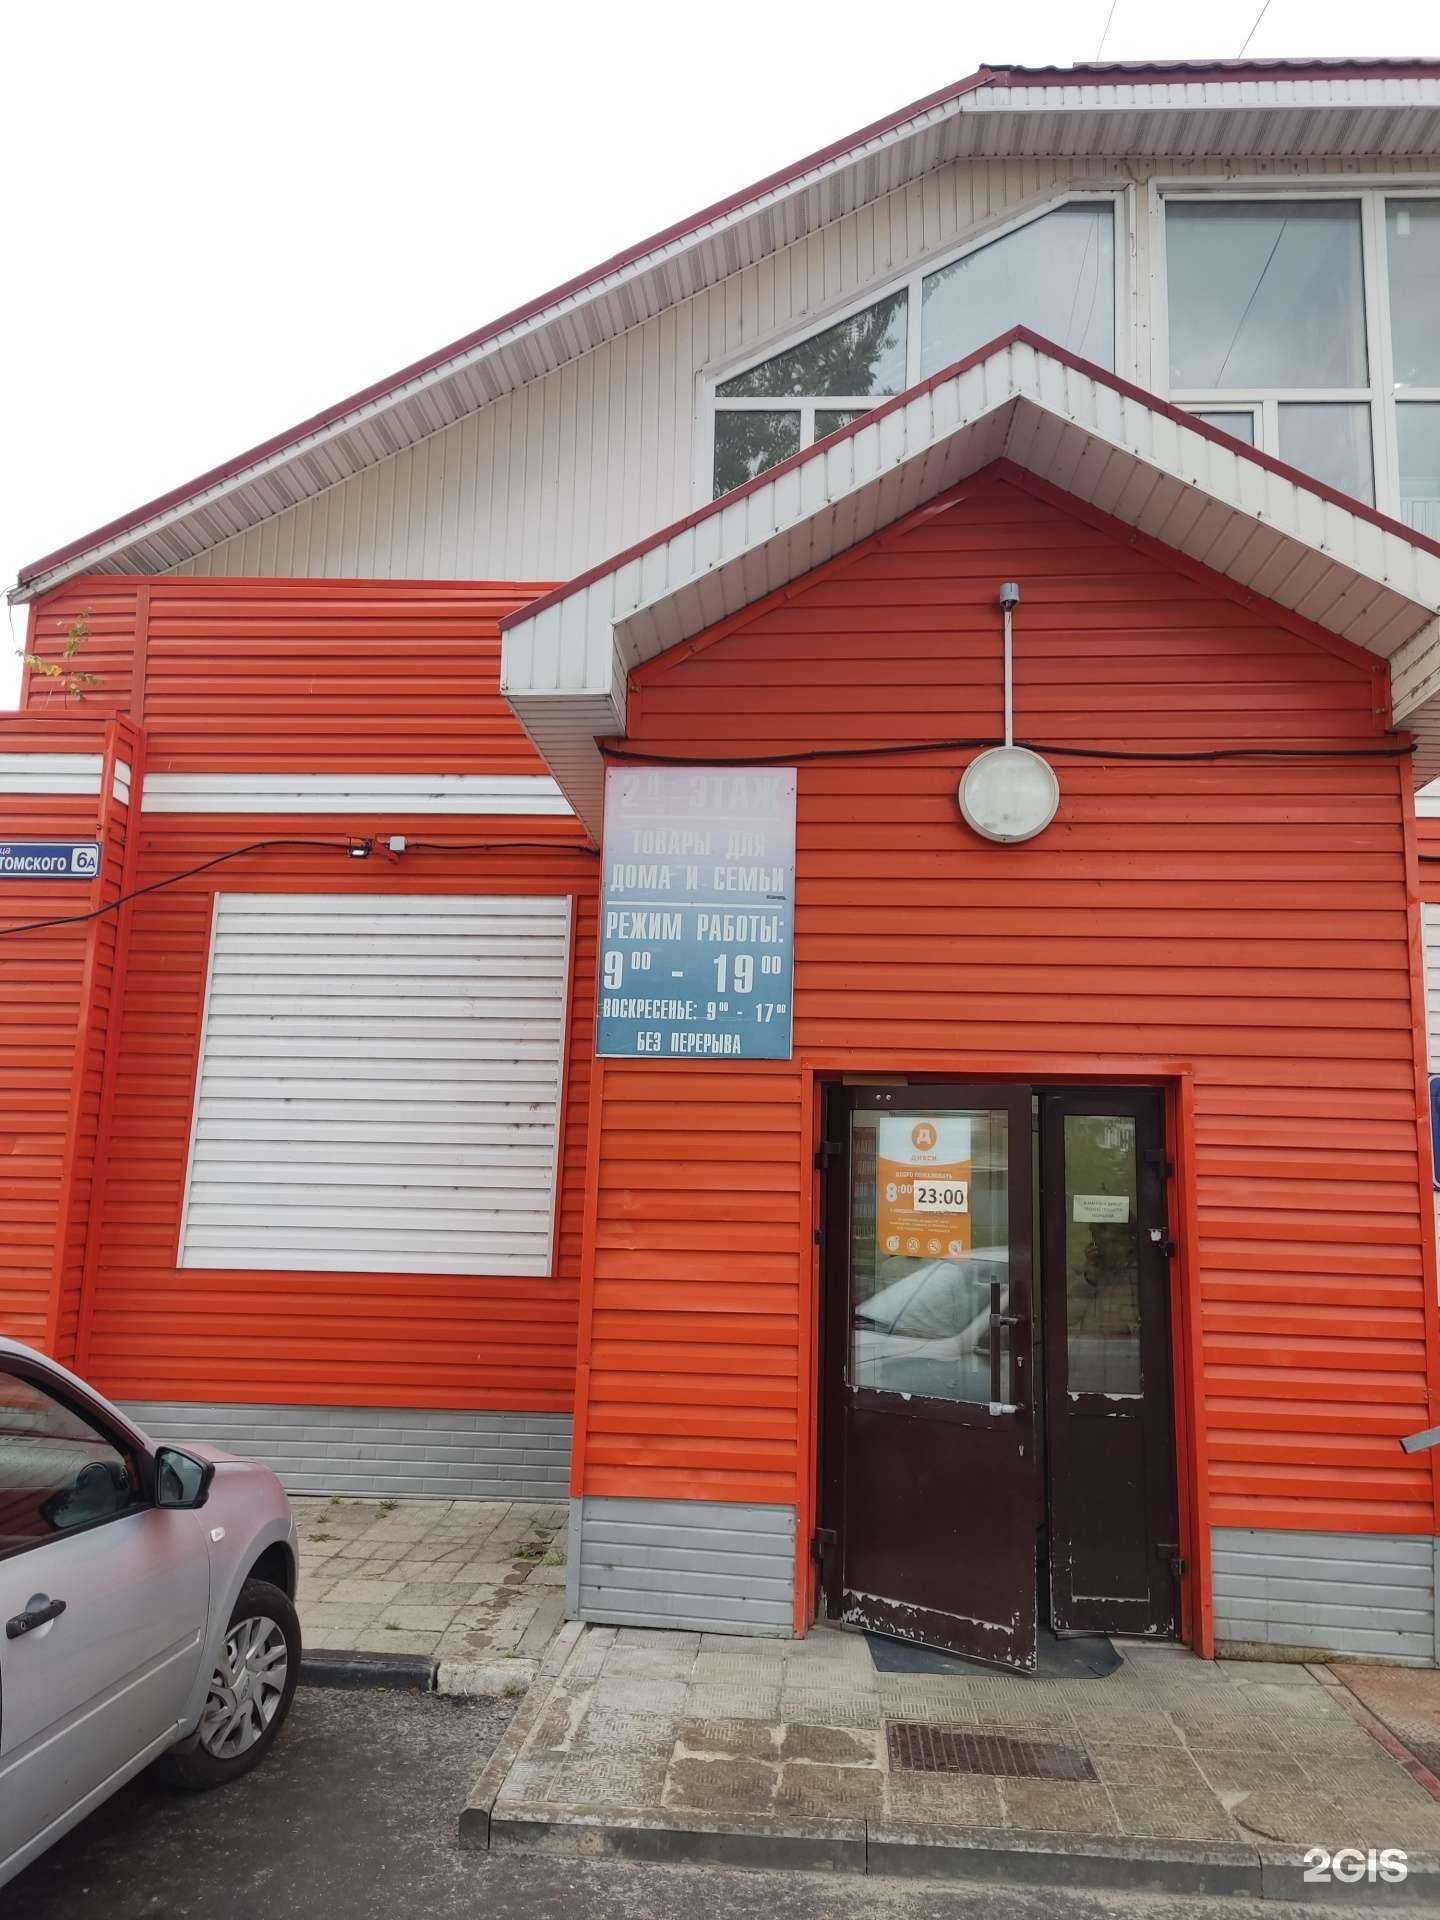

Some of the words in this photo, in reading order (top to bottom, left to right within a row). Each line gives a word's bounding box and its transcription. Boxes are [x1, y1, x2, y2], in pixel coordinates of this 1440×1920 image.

[632, 829, 711, 855] ТОВАРЫ
[725, 832, 766, 860] ДЛЯ
[610, 864, 671, 891] ДОМА
[686, 867, 698, 890] И
[713, 867, 784, 892] СЕМЬИ
[606, 911, 682, 941] РЕЖИМ
[697, 914, 784, 943] РАБОТЫ:
[603, 998, 697, 1020] ВОСКРЕСЕНЬЕ:
[637, 1031, 662, 1051] БЕЗ
[671, 1032, 741, 1054] ПЕРЕРЫВА
[918, 1188, 964, 1205] 23:00
